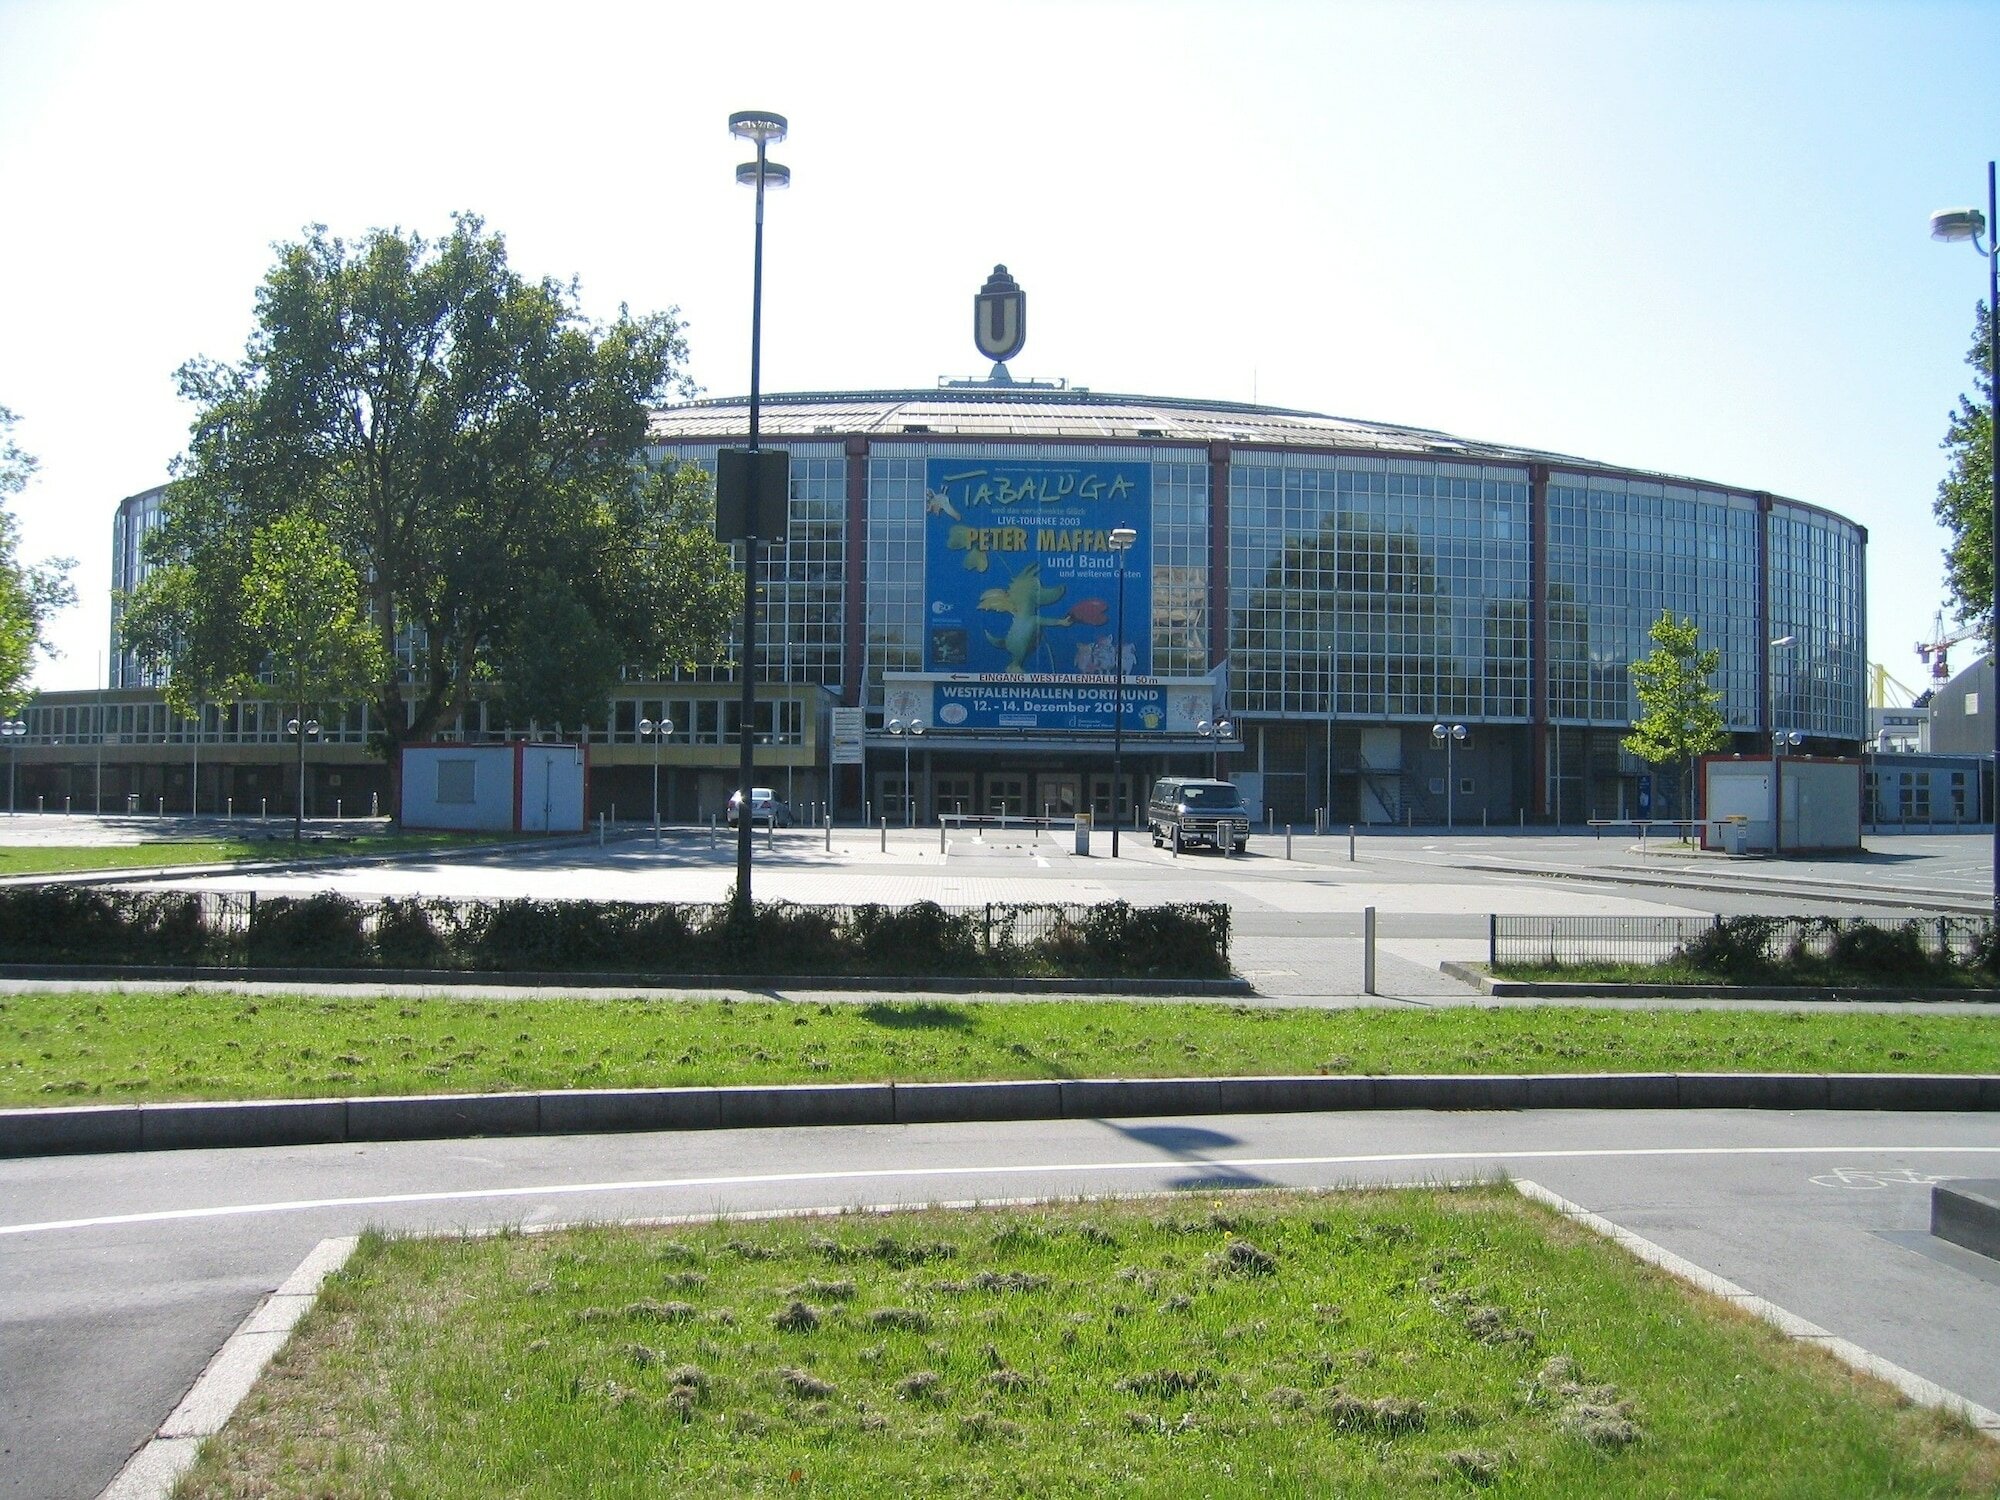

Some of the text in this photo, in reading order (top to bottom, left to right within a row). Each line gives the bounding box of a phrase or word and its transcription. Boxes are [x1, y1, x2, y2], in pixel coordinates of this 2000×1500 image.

[979, 298, 1017, 353] U
[943, 470, 1134, 506] TABALUGA
[997, 516, 1081, 526] LIVE-TOURNEE 2003
[967, 527, 1115, 552] PETER MAFFA
[1048, 554, 1114, 568] und Band
[1060, 569, 1141, 579] und weiteren Gsten
[979, 673, 1025, 682] EINGANG
[1030, 674, 1119, 683] WESTFALENHALLE
[1136, 676, 1148, 684] 50
[942, 686, 1158, 700] WESTFALENHALLEN DORTMUND
[1023, 701, 1090, 713] Dezember
